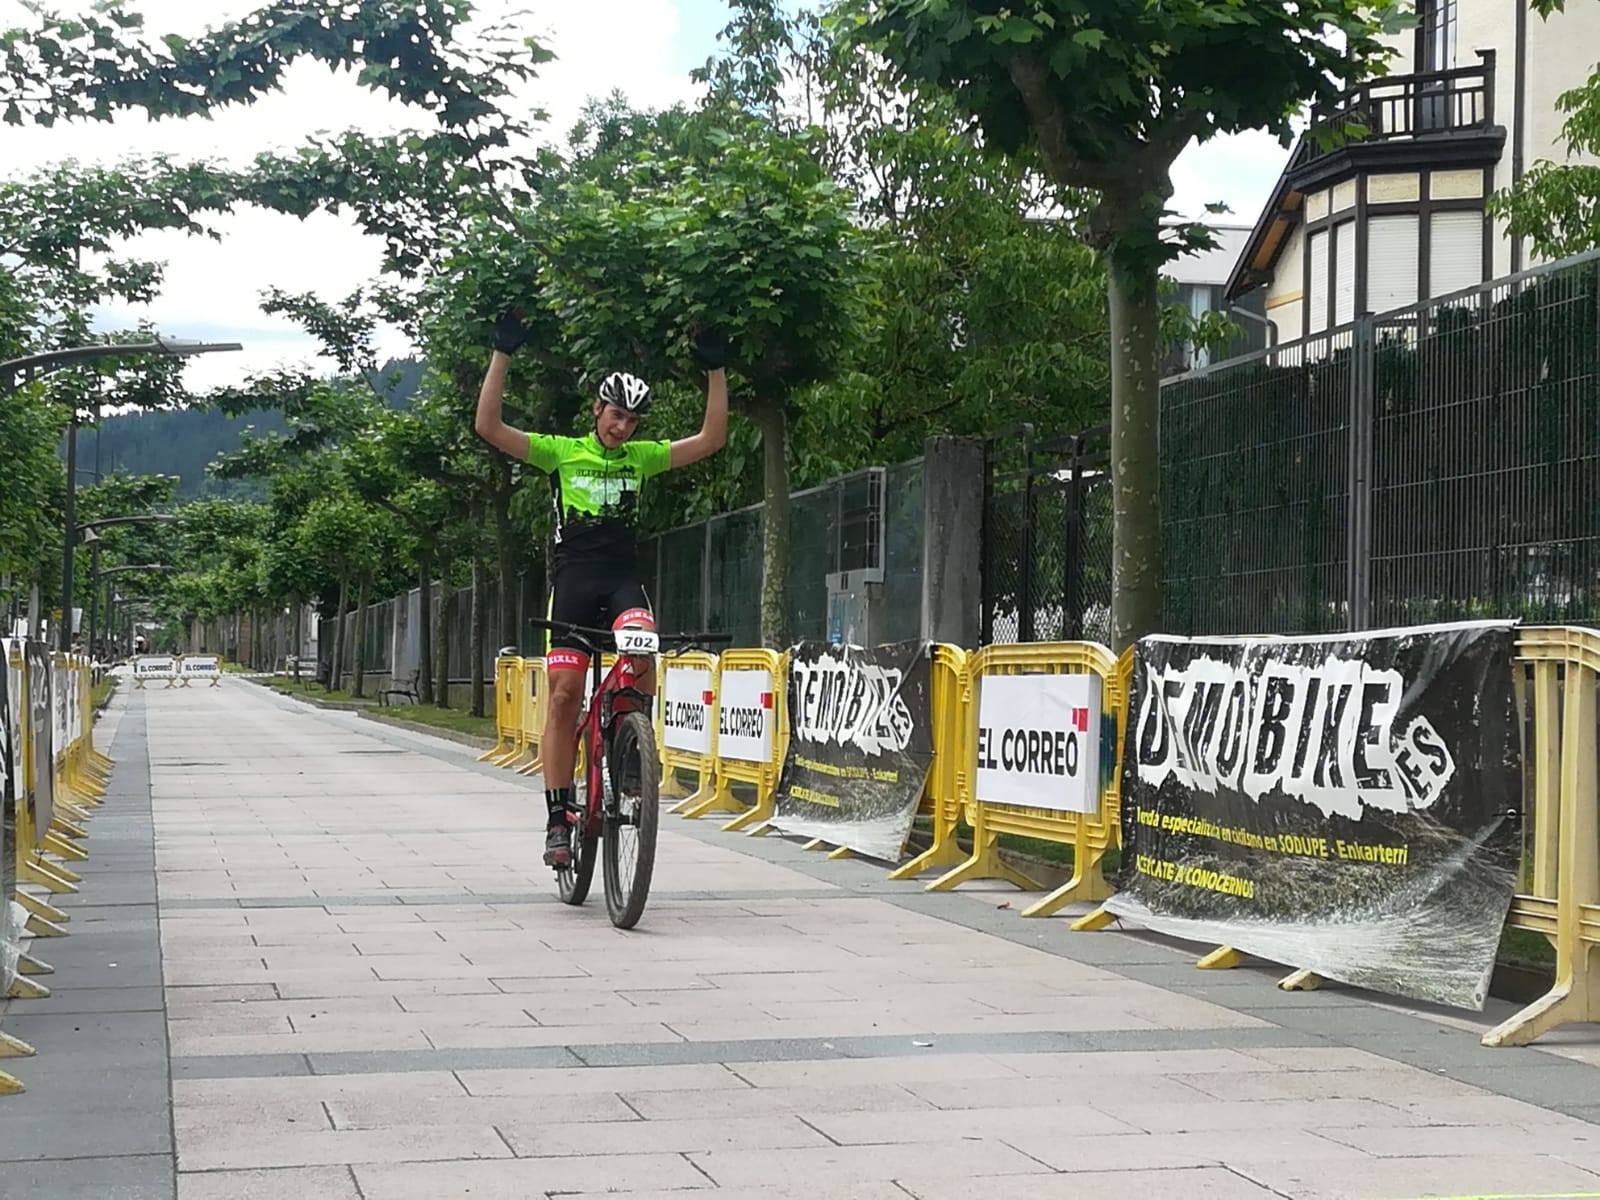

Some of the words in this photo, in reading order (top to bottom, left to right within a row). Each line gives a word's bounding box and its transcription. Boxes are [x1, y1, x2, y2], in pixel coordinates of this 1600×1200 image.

[624, 636, 653, 648] 702
[665, 701, 673, 726] EL
[675, 701, 705, 731] CORREO
[720, 707, 729, 735] EL
[730, 707, 764, 739] CORREO
[977, 728, 998, 769] EL
[1001, 728, 1079, 777] CORREO
[1264, 835, 1278, 851] en
[1279, 834, 1329, 859] SODUPE
[1336, 839, 1408, 865] Enkarterri
[1185, 866, 1254, 899] CONOCERNOS
